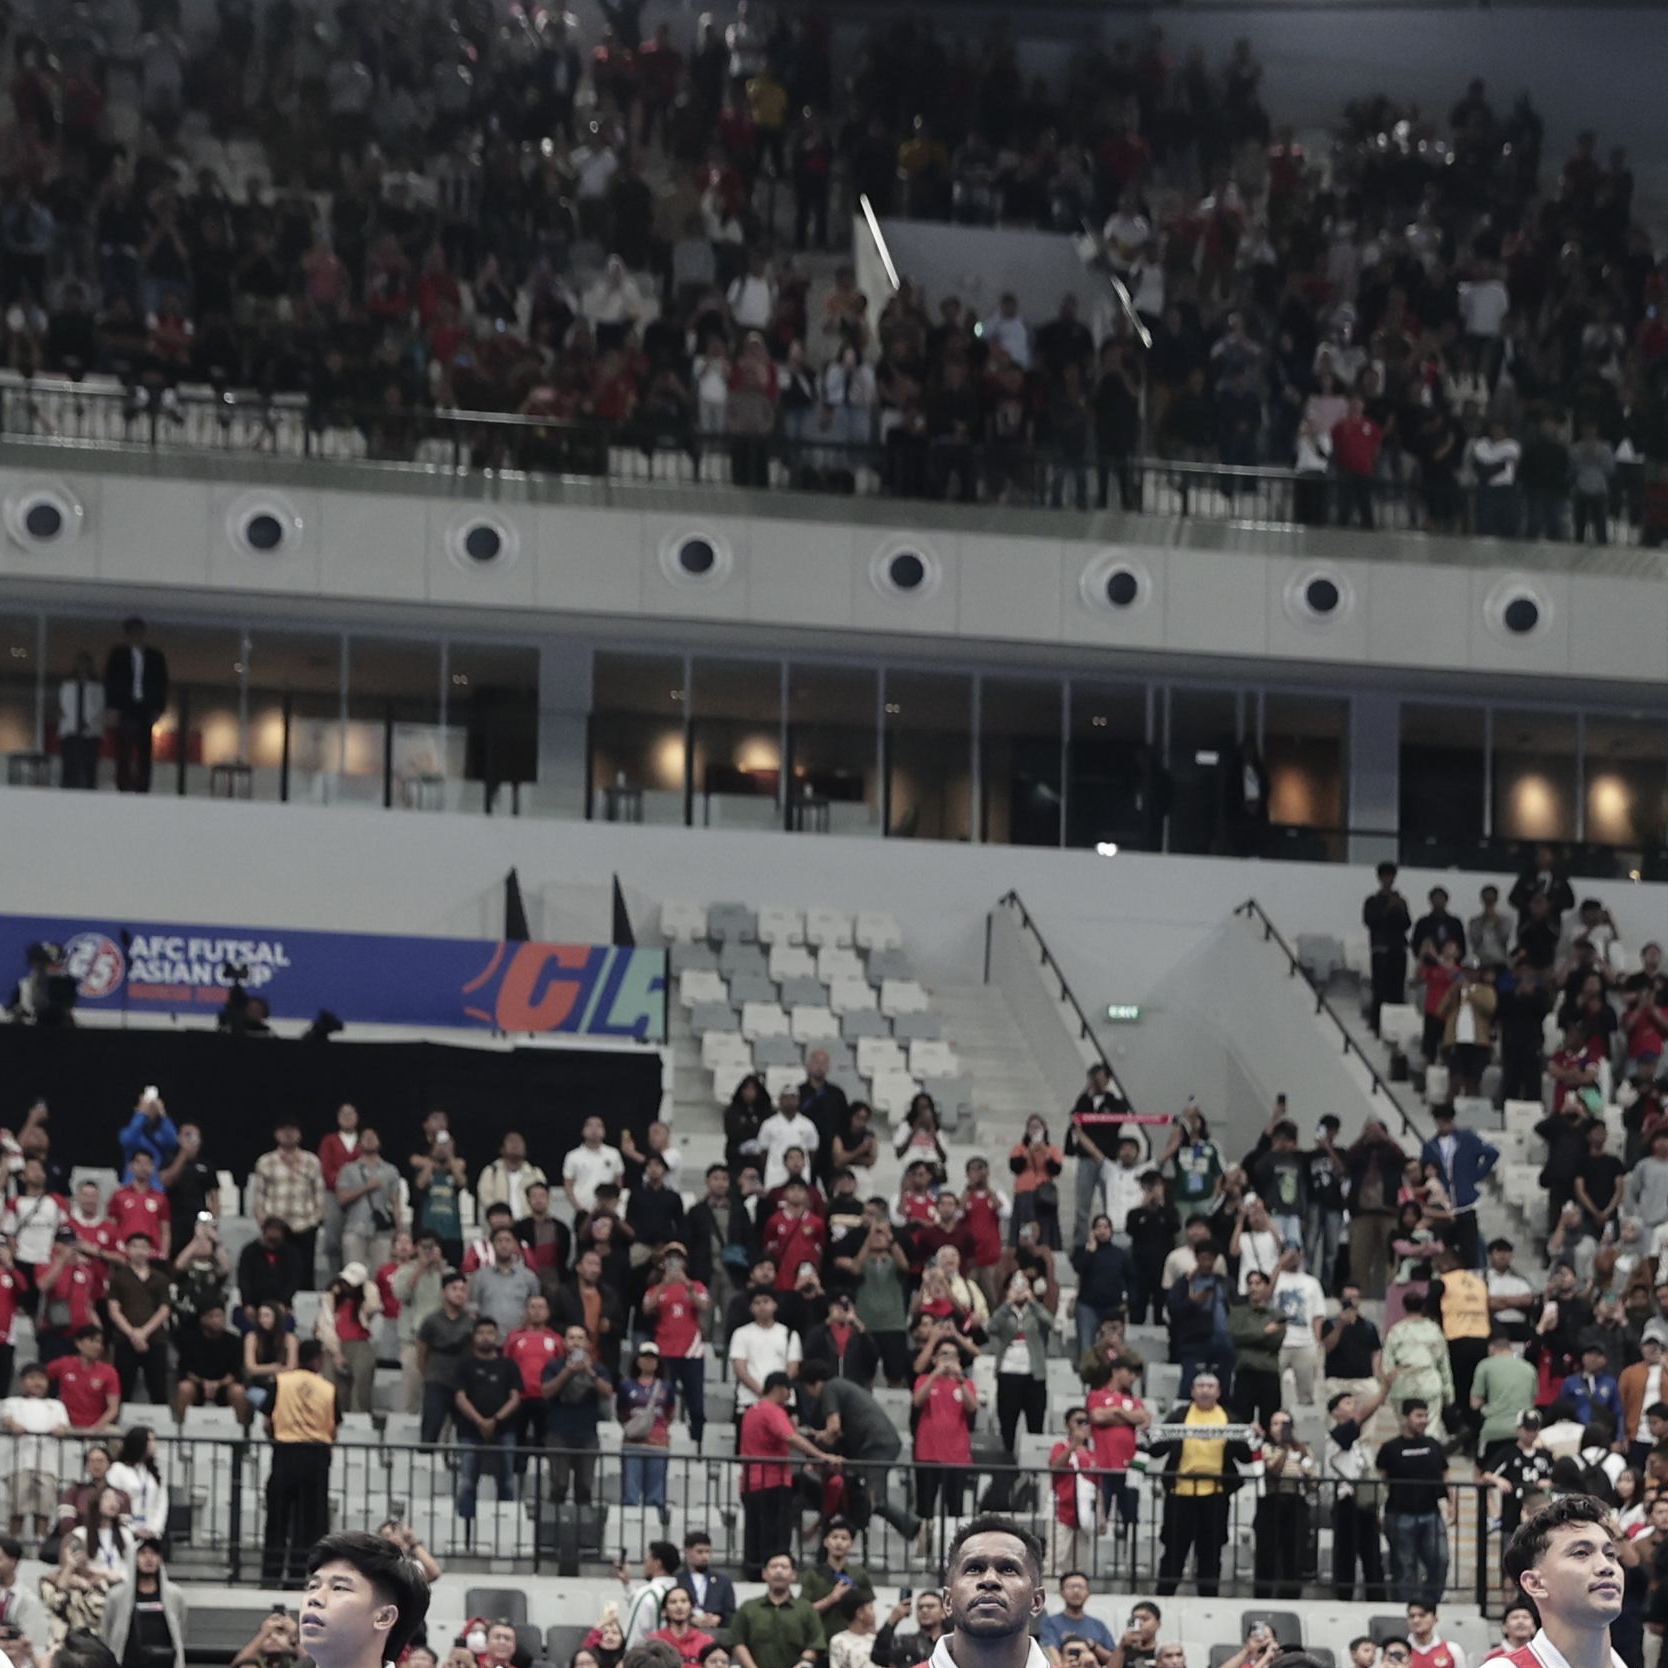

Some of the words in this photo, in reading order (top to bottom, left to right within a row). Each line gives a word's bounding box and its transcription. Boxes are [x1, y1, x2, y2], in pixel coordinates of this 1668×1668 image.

[129, 936, 185, 960] AFC
[188, 937, 290, 966] FUTSAL
[128, 960, 211, 985] ASIAN
